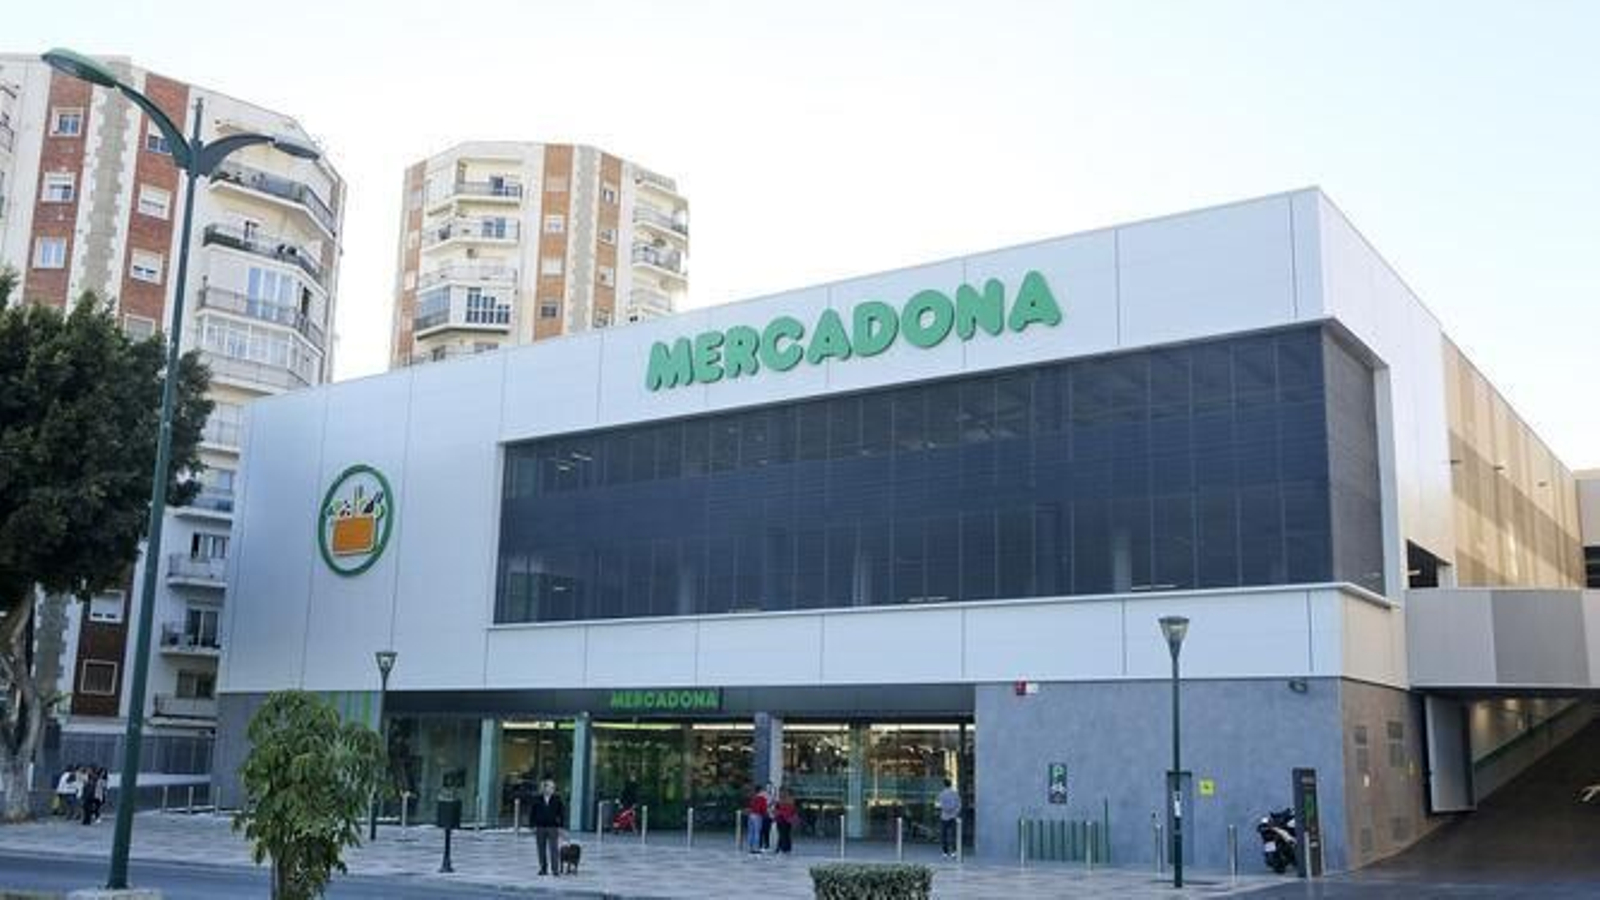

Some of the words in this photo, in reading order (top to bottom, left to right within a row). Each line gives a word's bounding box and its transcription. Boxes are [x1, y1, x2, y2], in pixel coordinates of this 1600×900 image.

[647, 270, 1063, 391] MERCADONA
[610, 690, 718, 708] MERCADONA
[1053, 765, 1065, 778] P
